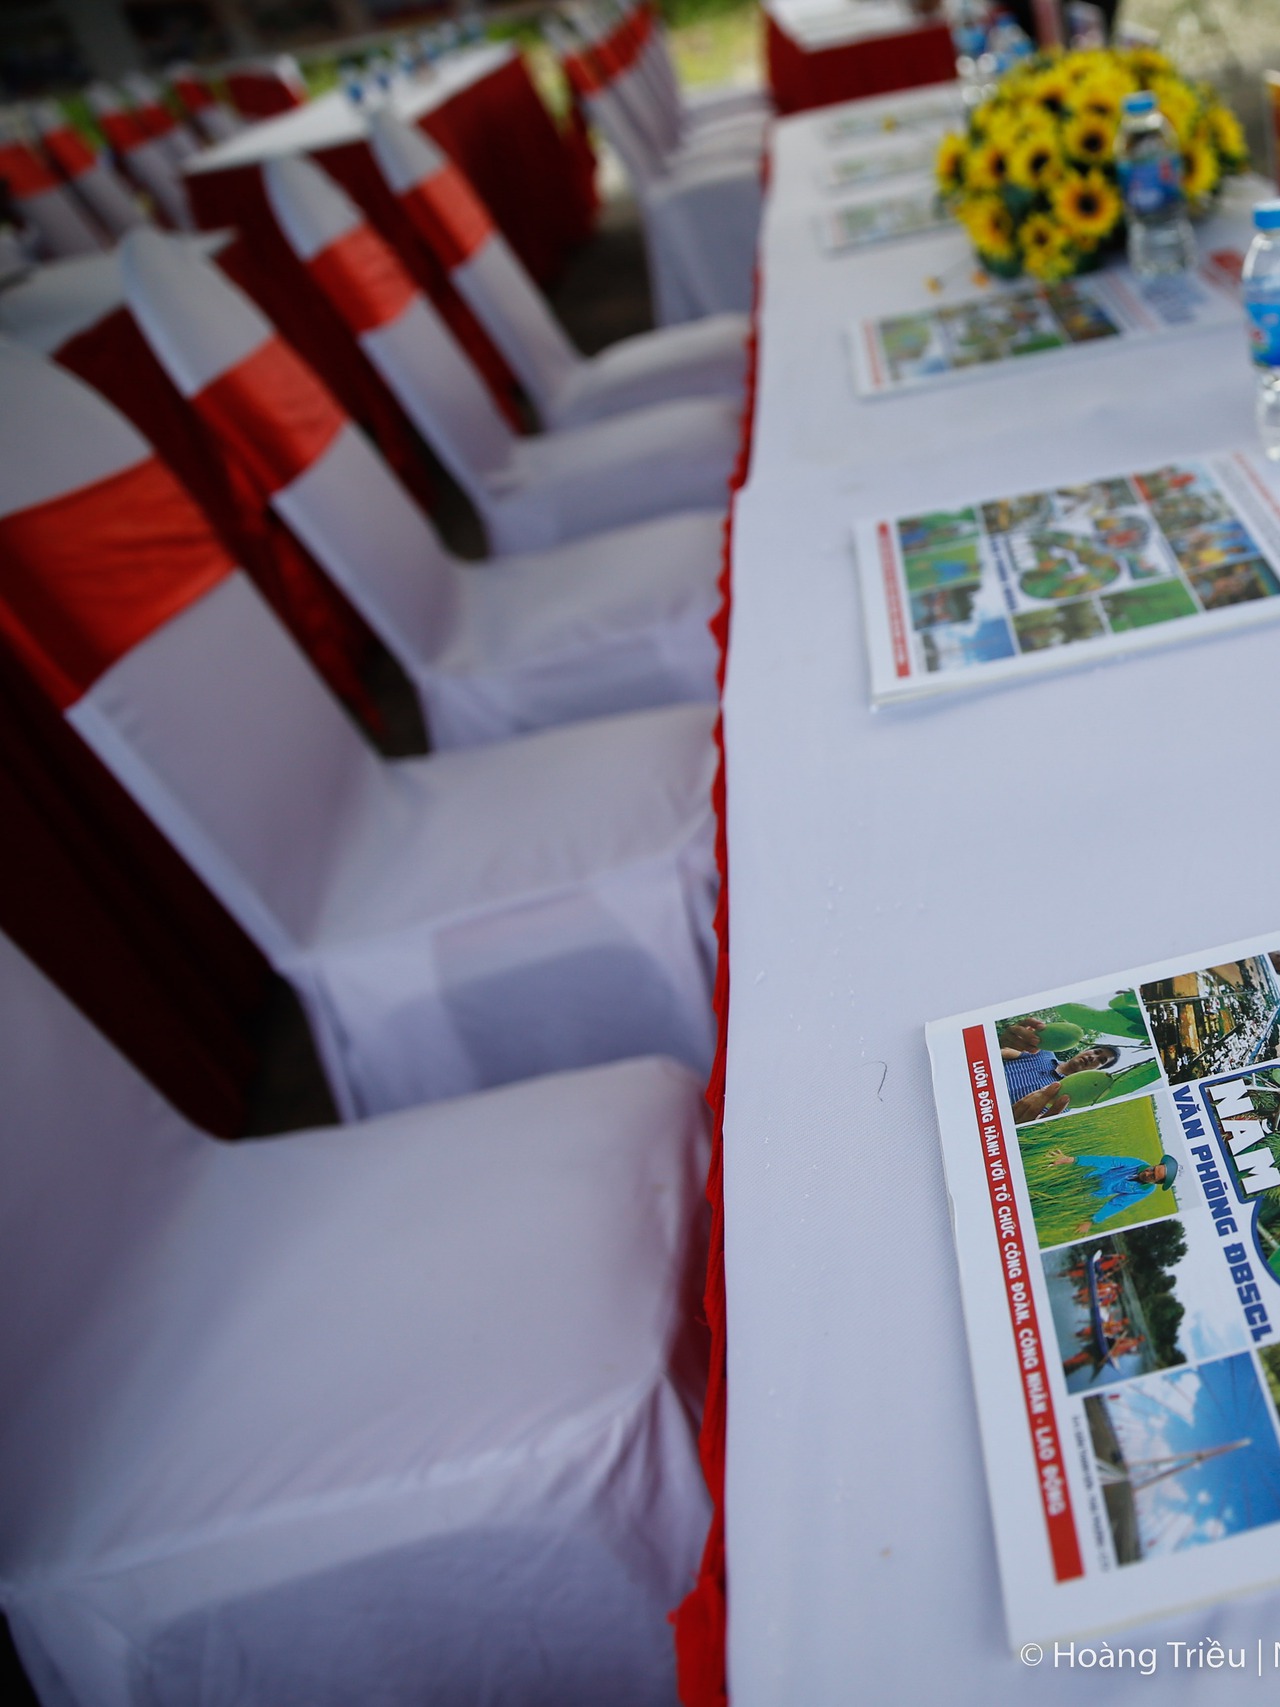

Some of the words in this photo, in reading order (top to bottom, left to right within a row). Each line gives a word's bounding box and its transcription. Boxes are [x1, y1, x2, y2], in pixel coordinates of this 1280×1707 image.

[972, 1060, 988, 1088] LUÔN
[977, 1090, 993, 1123] ĐỒNG
[983, 1125, 1000, 1157] HÀNH
[989, 1159, 1006, 1181] VỚI
[993, 1183, 1012, 1201] TỔ
[997, 1205, 1015, 1238] CHỨC
[1172, 1084, 1205, 1139] VĂN
[1222, 1242, 1272, 1343] ĐBSCL
[1003, 1242, 1021, 1279] CÔNG
[1018, 1328, 1038, 1369] CÔNG
[1026, 1371, 1046, 1414] NHÂN
[1034, 1426, 1054, 1460] LAO
[1041, 1465, 1064, 1515] ĐỘNG
